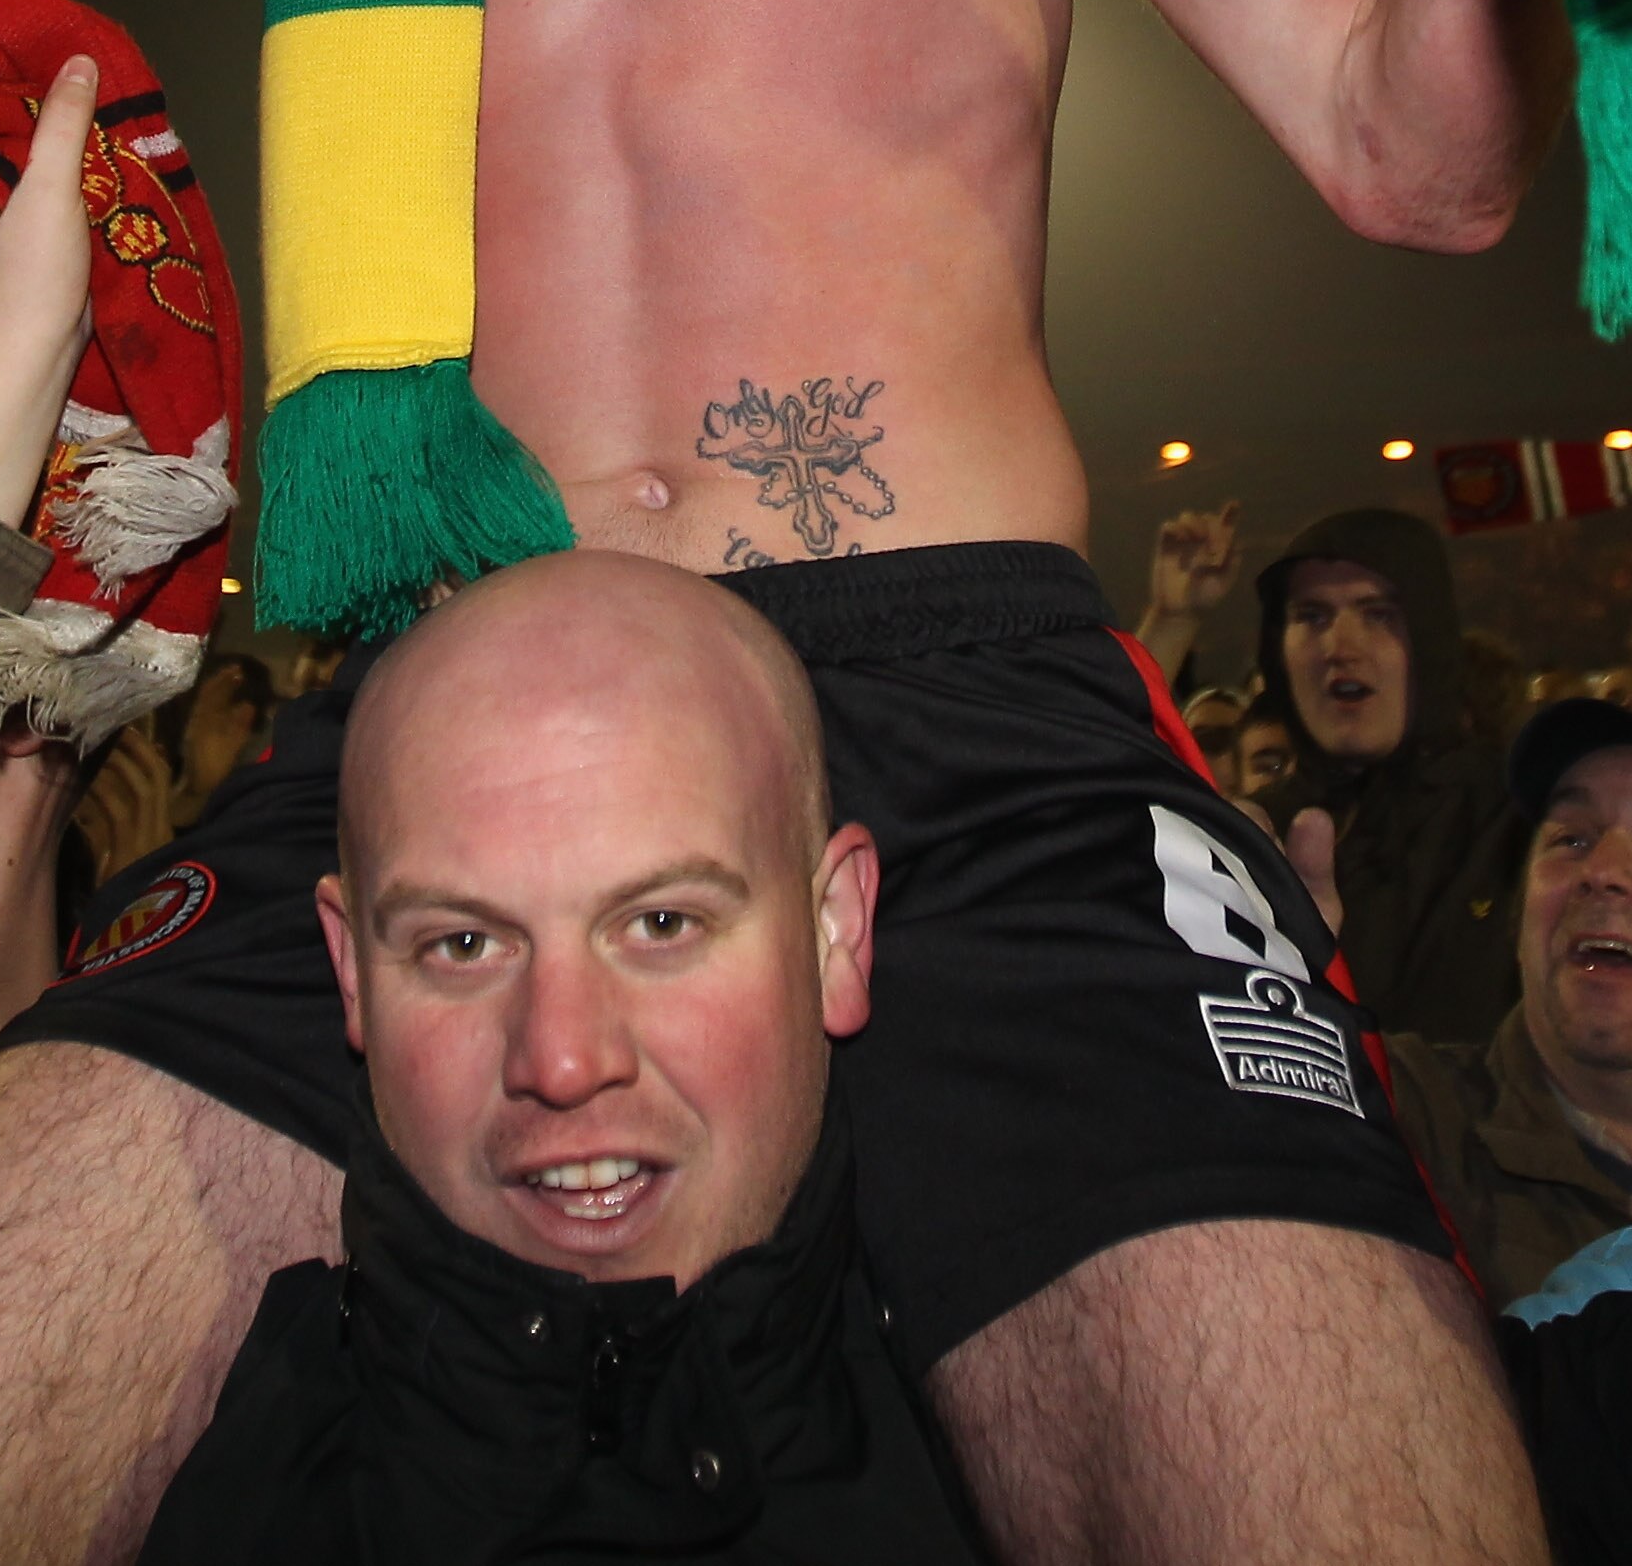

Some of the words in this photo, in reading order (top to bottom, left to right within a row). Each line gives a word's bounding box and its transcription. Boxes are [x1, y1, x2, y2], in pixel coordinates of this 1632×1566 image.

[705, 379, 775, 437] Only
[803, 377, 884, 437] God
[1238, 1054, 1350, 1101] Admiral
